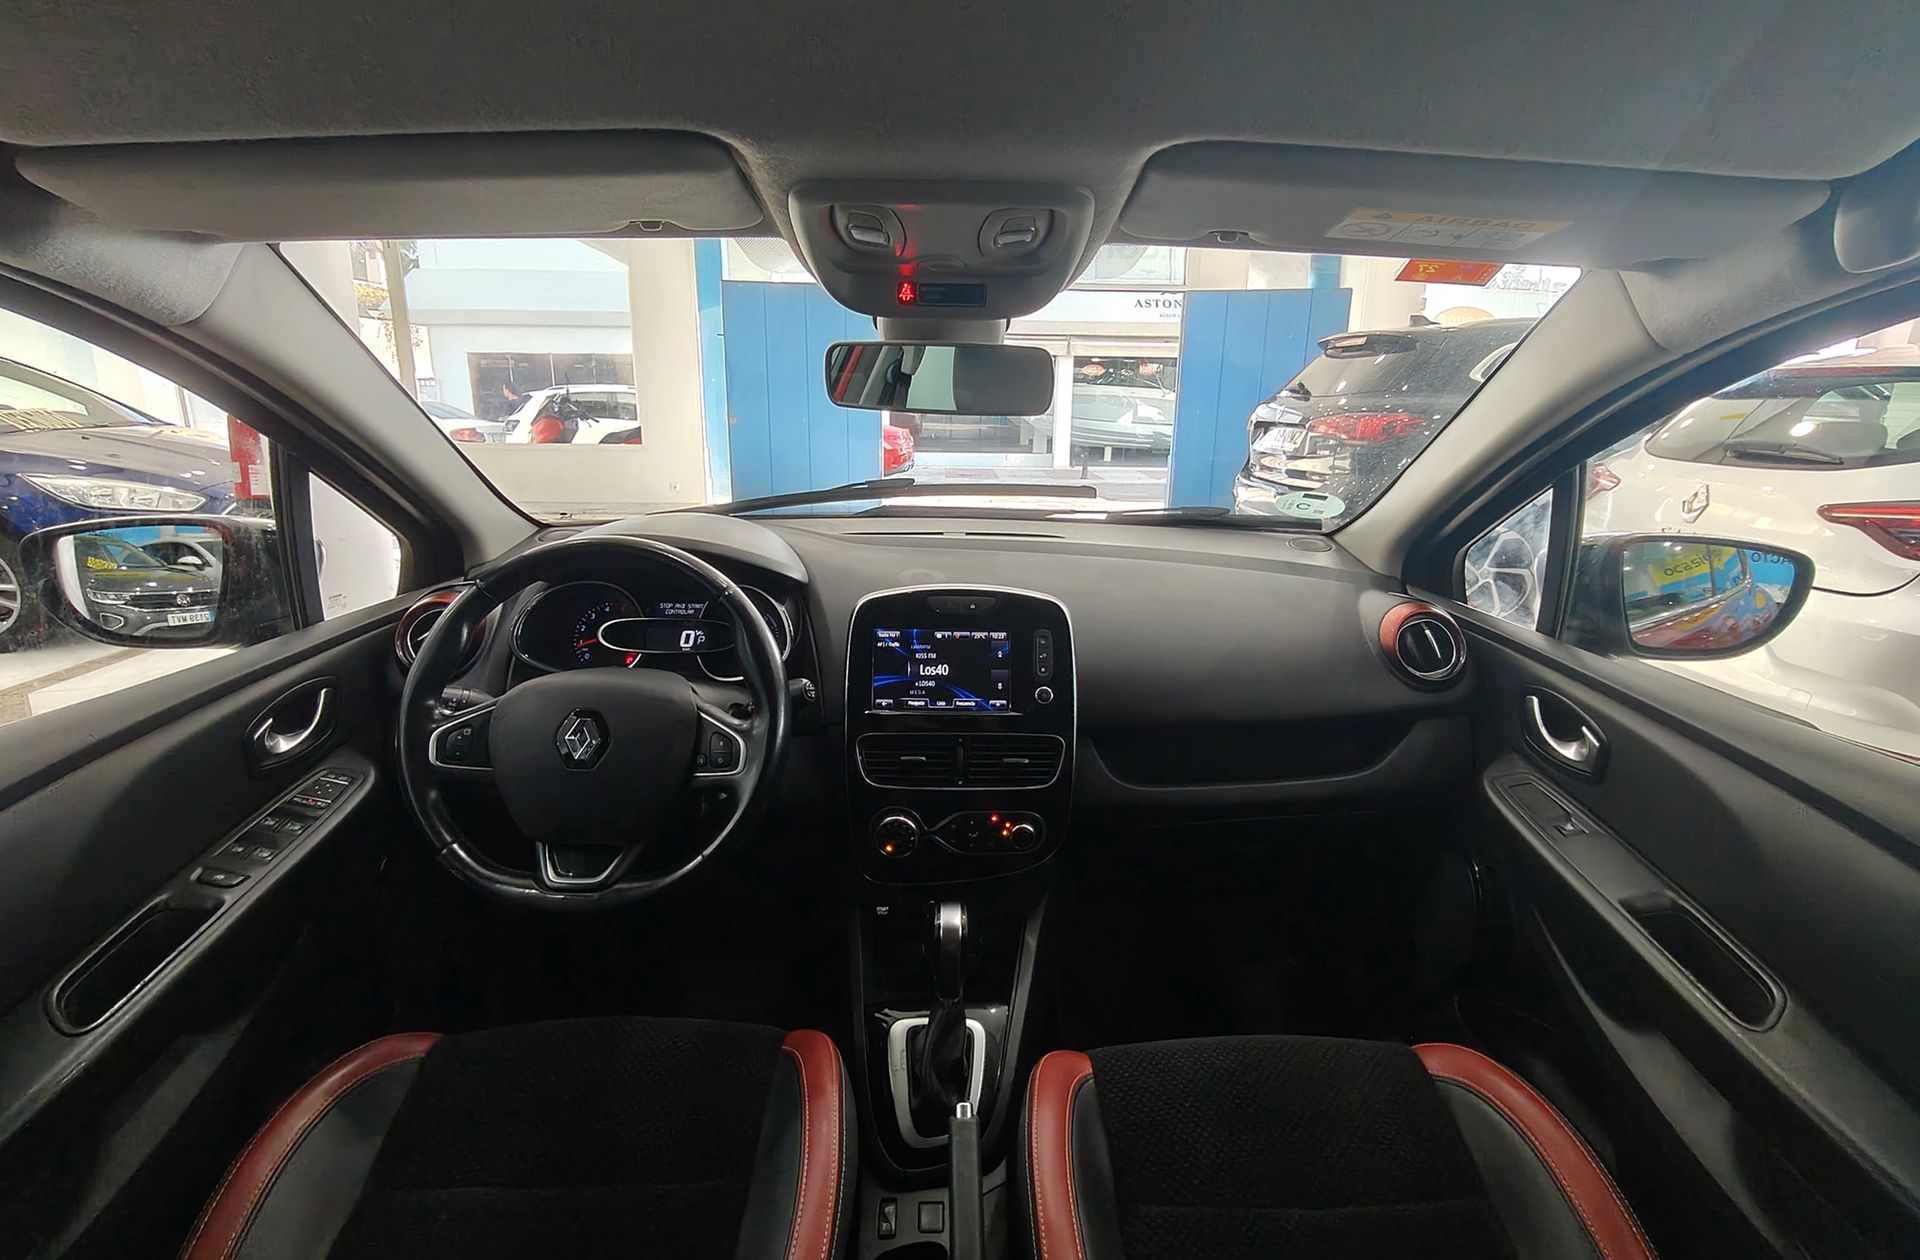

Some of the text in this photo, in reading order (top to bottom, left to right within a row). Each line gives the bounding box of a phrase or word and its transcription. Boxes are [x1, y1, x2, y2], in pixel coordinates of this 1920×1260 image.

[1413, 214, 1536, 229] AIRBAG
[1134, 298, 1183, 309] ASTON
[680, 630, 695, 647] 0
[920, 664, 949, 676] Los40
